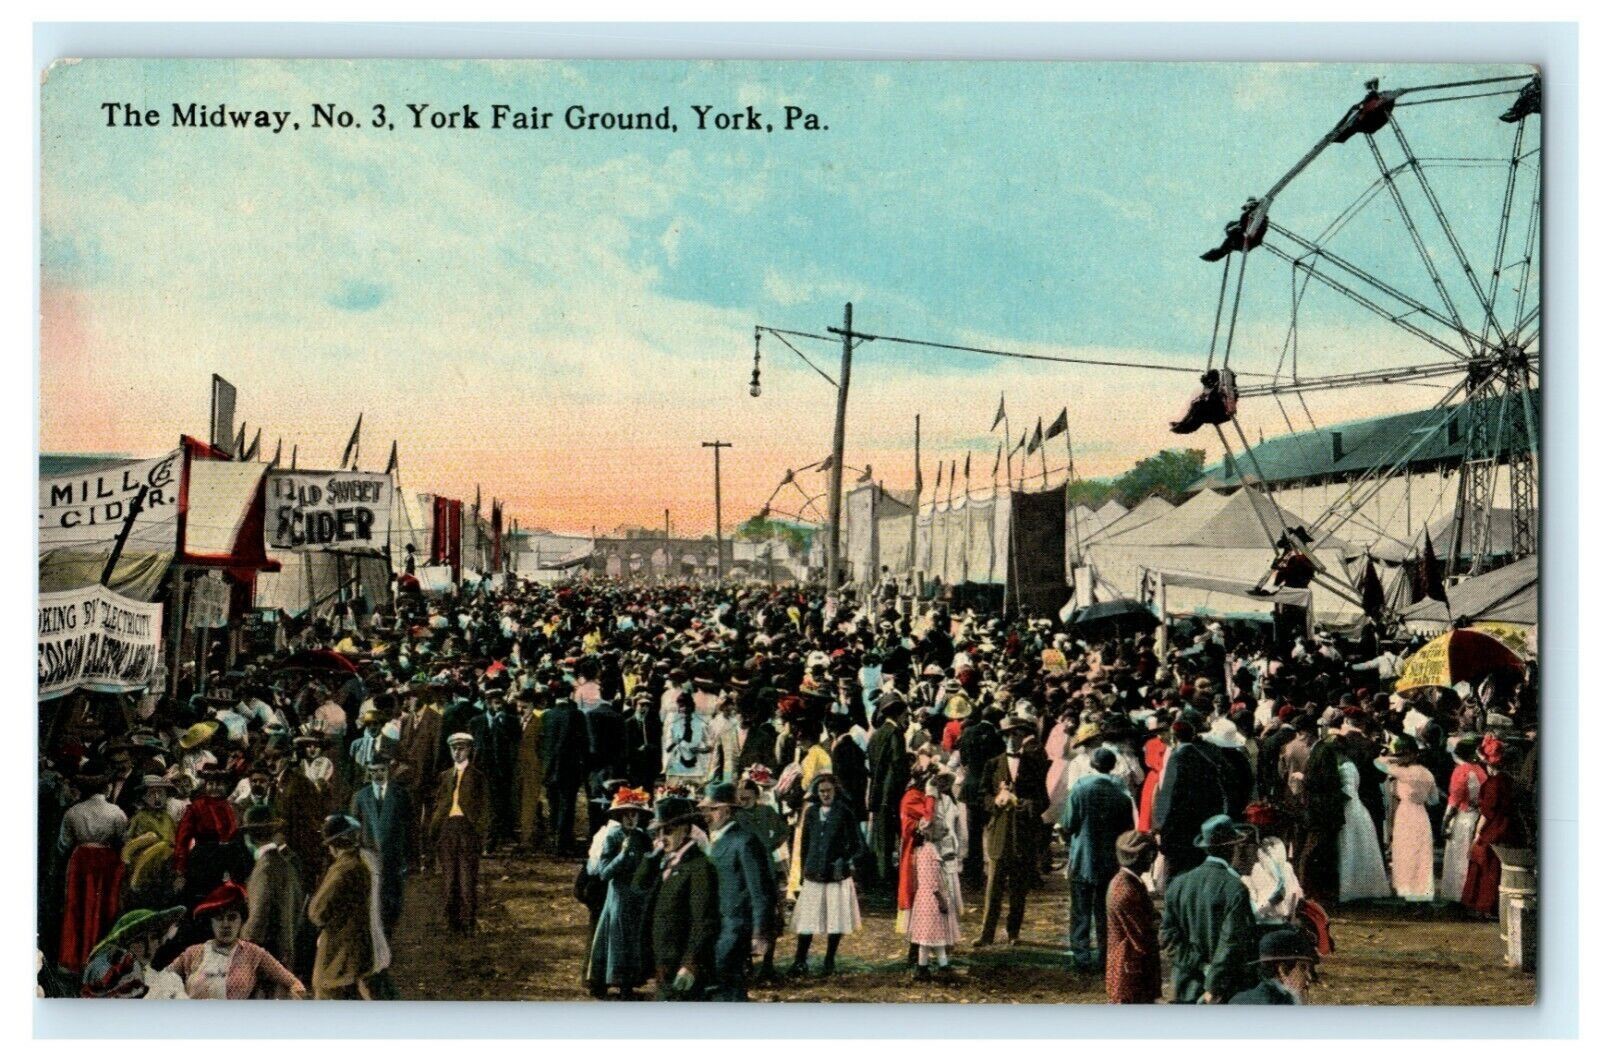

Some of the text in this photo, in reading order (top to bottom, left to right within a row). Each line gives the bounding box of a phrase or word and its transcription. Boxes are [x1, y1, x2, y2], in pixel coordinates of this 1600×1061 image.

[51, 470, 140, 507] MILL
[326, 478, 384, 505] SWEET
[60, 488, 176, 529] CIDR.
[291, 506, 375, 547] CIDER
[83, 598, 100, 626] BY
[101, 600, 152, 637] ELECTRICITY
